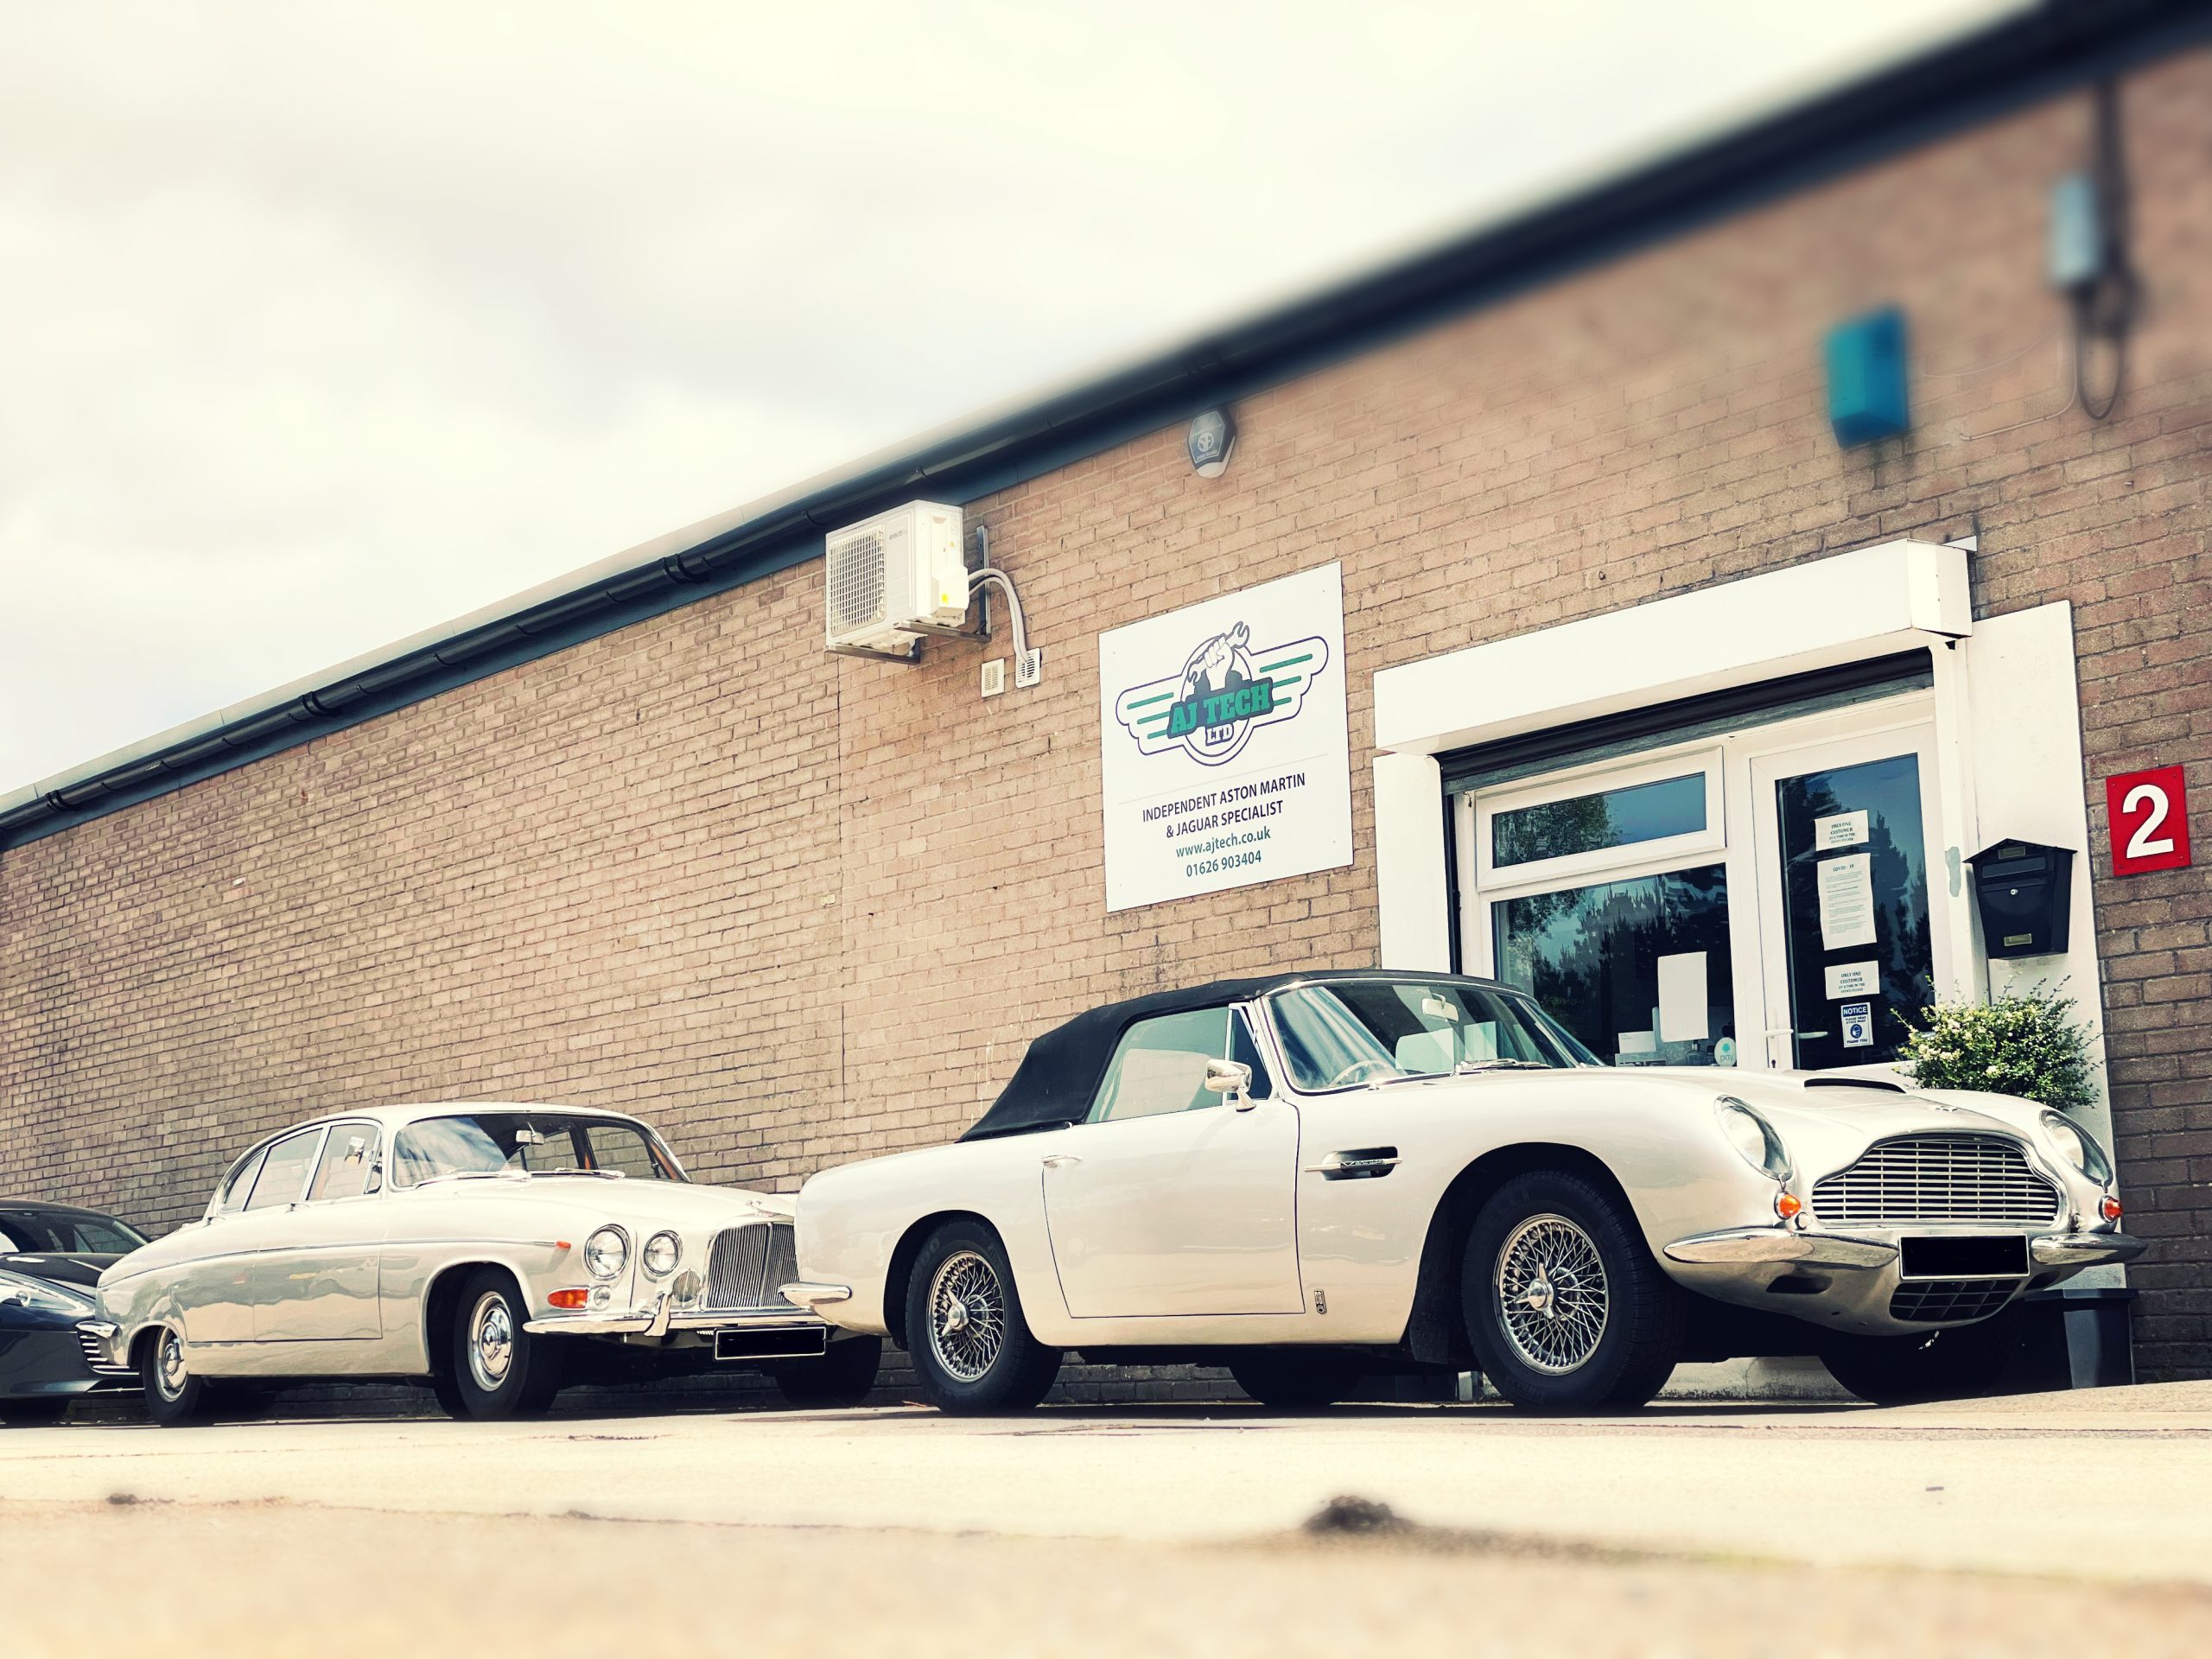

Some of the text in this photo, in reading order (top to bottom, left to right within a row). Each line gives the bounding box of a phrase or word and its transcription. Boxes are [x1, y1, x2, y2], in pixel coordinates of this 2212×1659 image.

[1171, 683, 1270, 734] AJ TECH
[1206, 724, 1233, 744] LTD
[1142, 772, 1306, 823] INDEPENDENT ASTON MARTIN
[1166, 800, 1283, 838] & JAGUAR SPECIALIST
[2122, 784, 2174, 859] 2
[1176, 825, 1271, 857] www.ajtech.co.uk
[1186, 850, 1262, 877] 01626 903404
[1843, 1007, 1867, 1015] NOTICE
